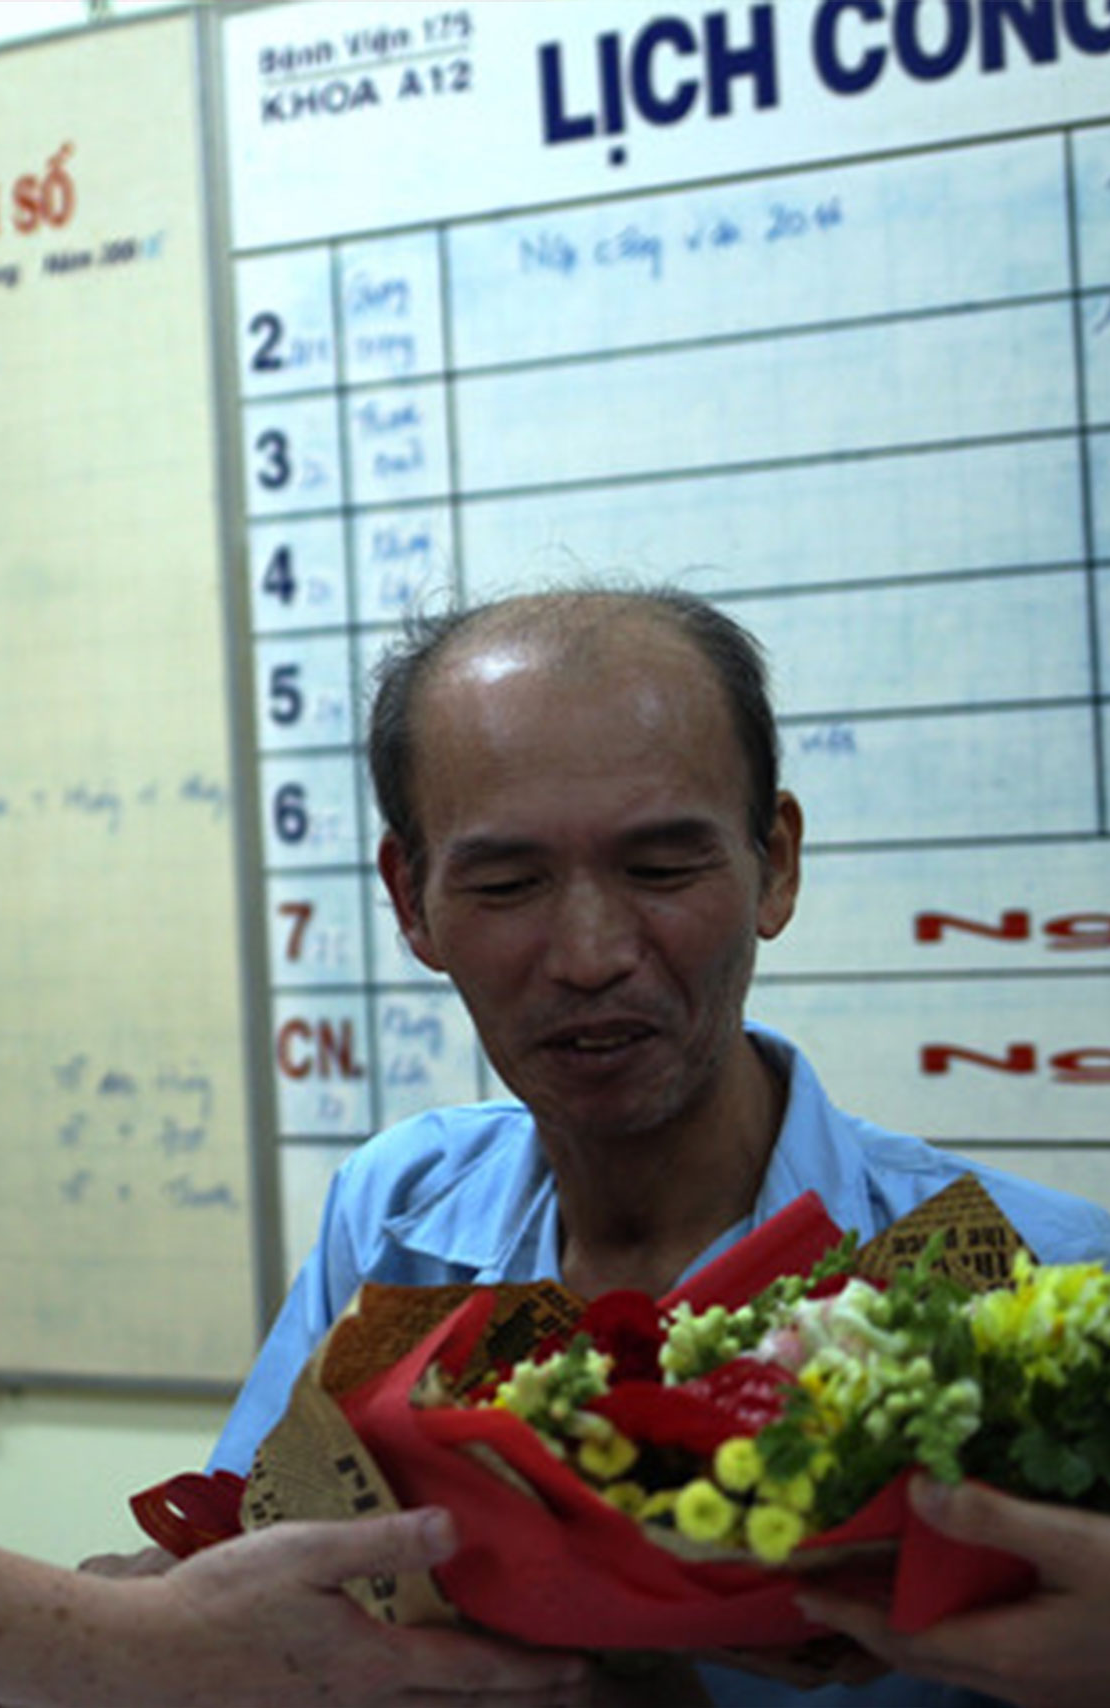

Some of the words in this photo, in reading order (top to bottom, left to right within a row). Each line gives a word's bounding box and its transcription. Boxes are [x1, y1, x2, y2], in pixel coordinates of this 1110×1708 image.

[261, 77, 380, 125] KHOA
[398, 59, 472, 98] A12
[538, 8, 778, 166] LỊCH
[11, 142, 75, 234] SỐ
[249, 312, 284, 372] 2
[256, 430, 292, 490] 3
[263, 545, 297, 604] 4
[270, 664, 303, 726] 5
[273, 782, 308, 845] 6
[278, 904, 314, 961] 7
